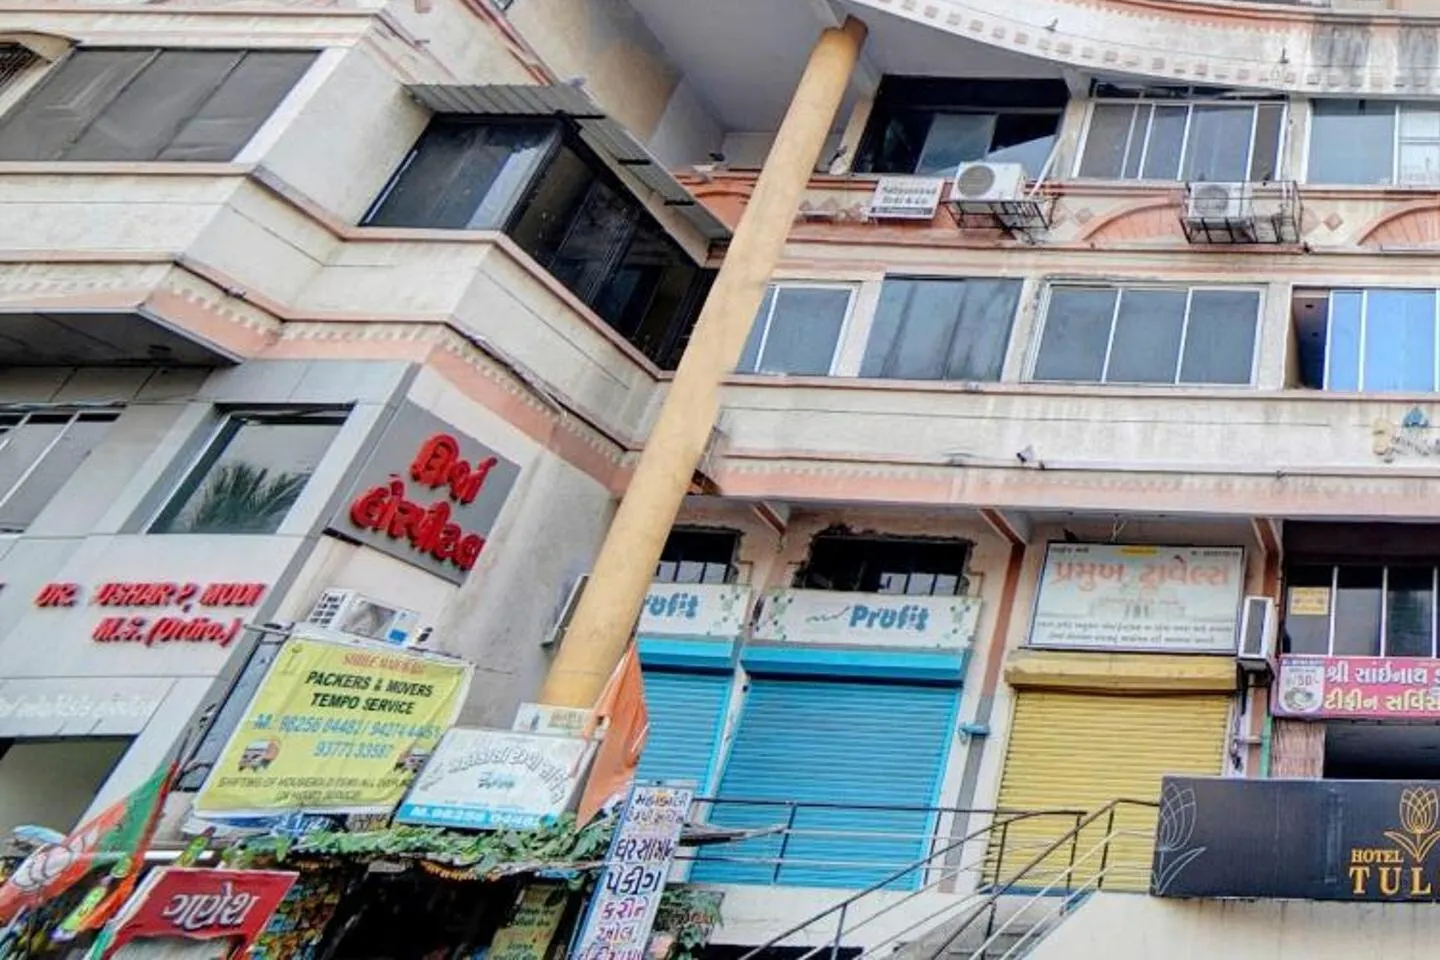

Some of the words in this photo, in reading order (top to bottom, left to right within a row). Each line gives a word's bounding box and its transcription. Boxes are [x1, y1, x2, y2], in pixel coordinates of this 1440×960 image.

[643, 592, 699, 619] rofit
[849, 603, 931, 631] Profit
[1327, 660, 1349, 683] શ્રી
[304, 671, 372, 692] PACKERS
[384, 679, 434, 698] MOVERS
[310, 692, 359, 710] TEMPO
[361, 694, 416, 715] SERVICE
[1351, 849, 1404, 863] HOTEL
